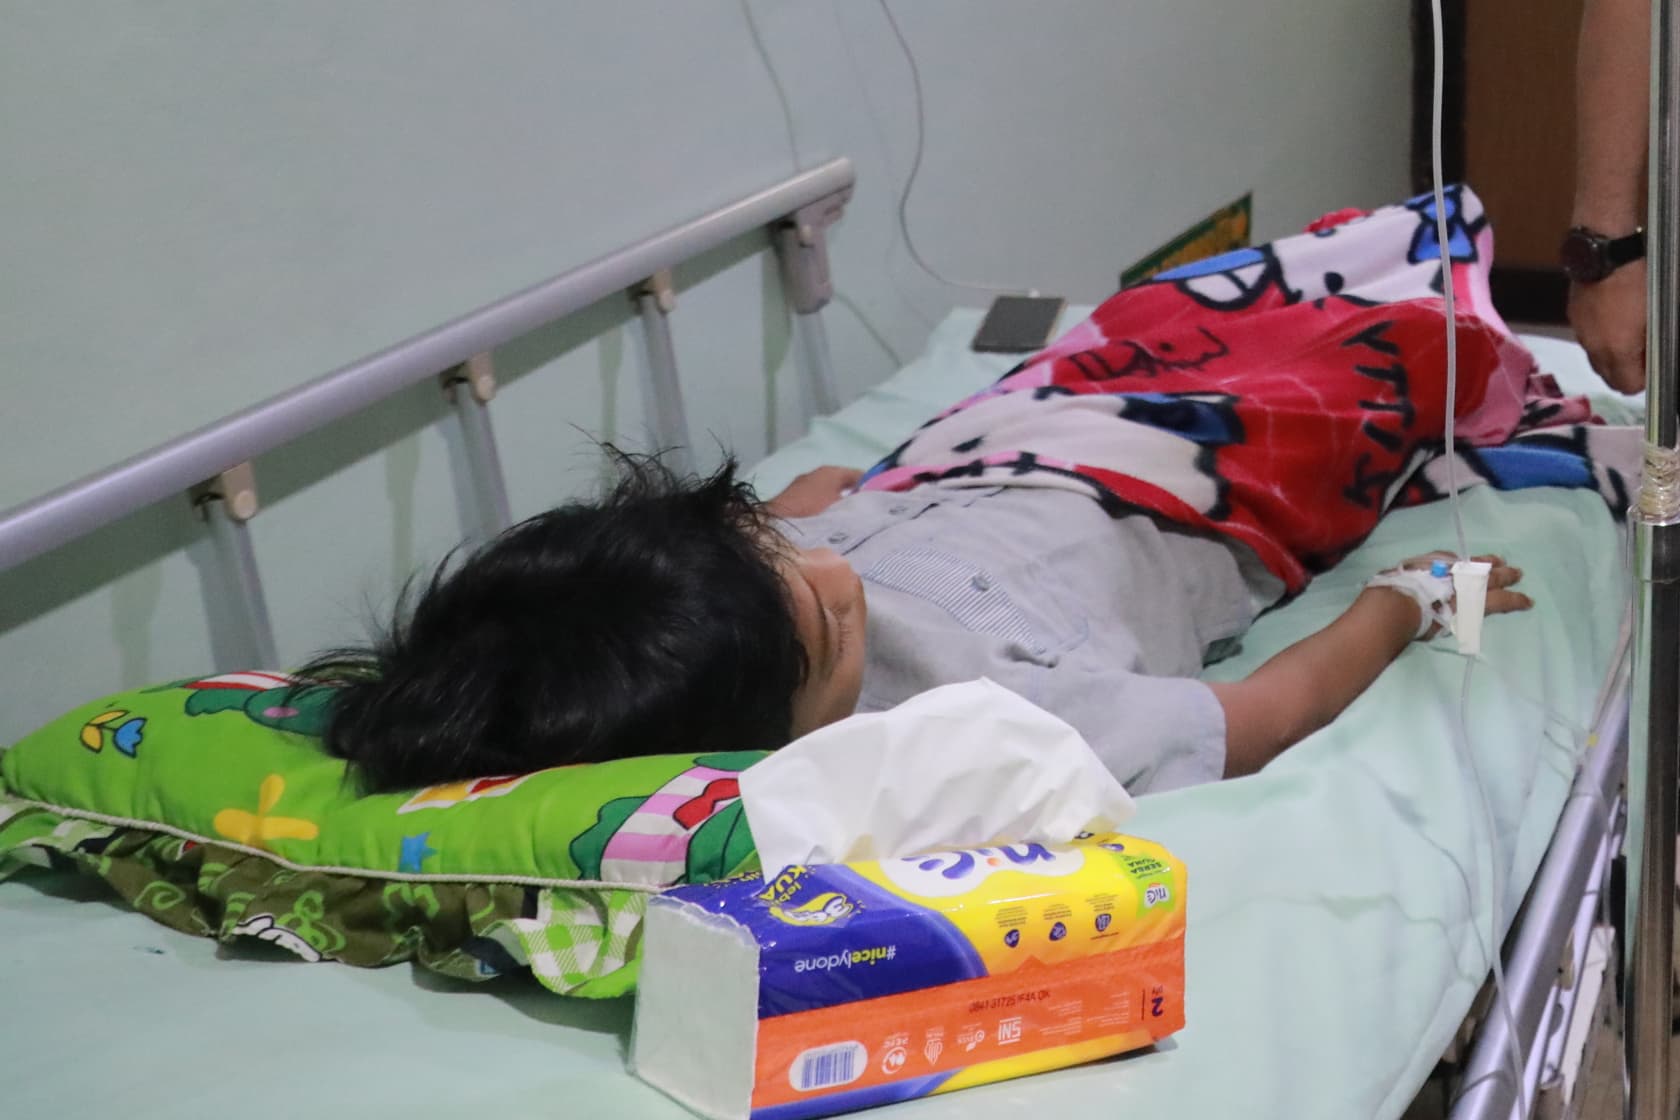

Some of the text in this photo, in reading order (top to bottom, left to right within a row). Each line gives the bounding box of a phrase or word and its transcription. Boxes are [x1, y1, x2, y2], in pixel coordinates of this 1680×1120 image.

[795, 945, 897, 973] #nicelydone
[1151, 997, 1163, 1017] 2
[998, 1020, 1022, 1040] SNI
